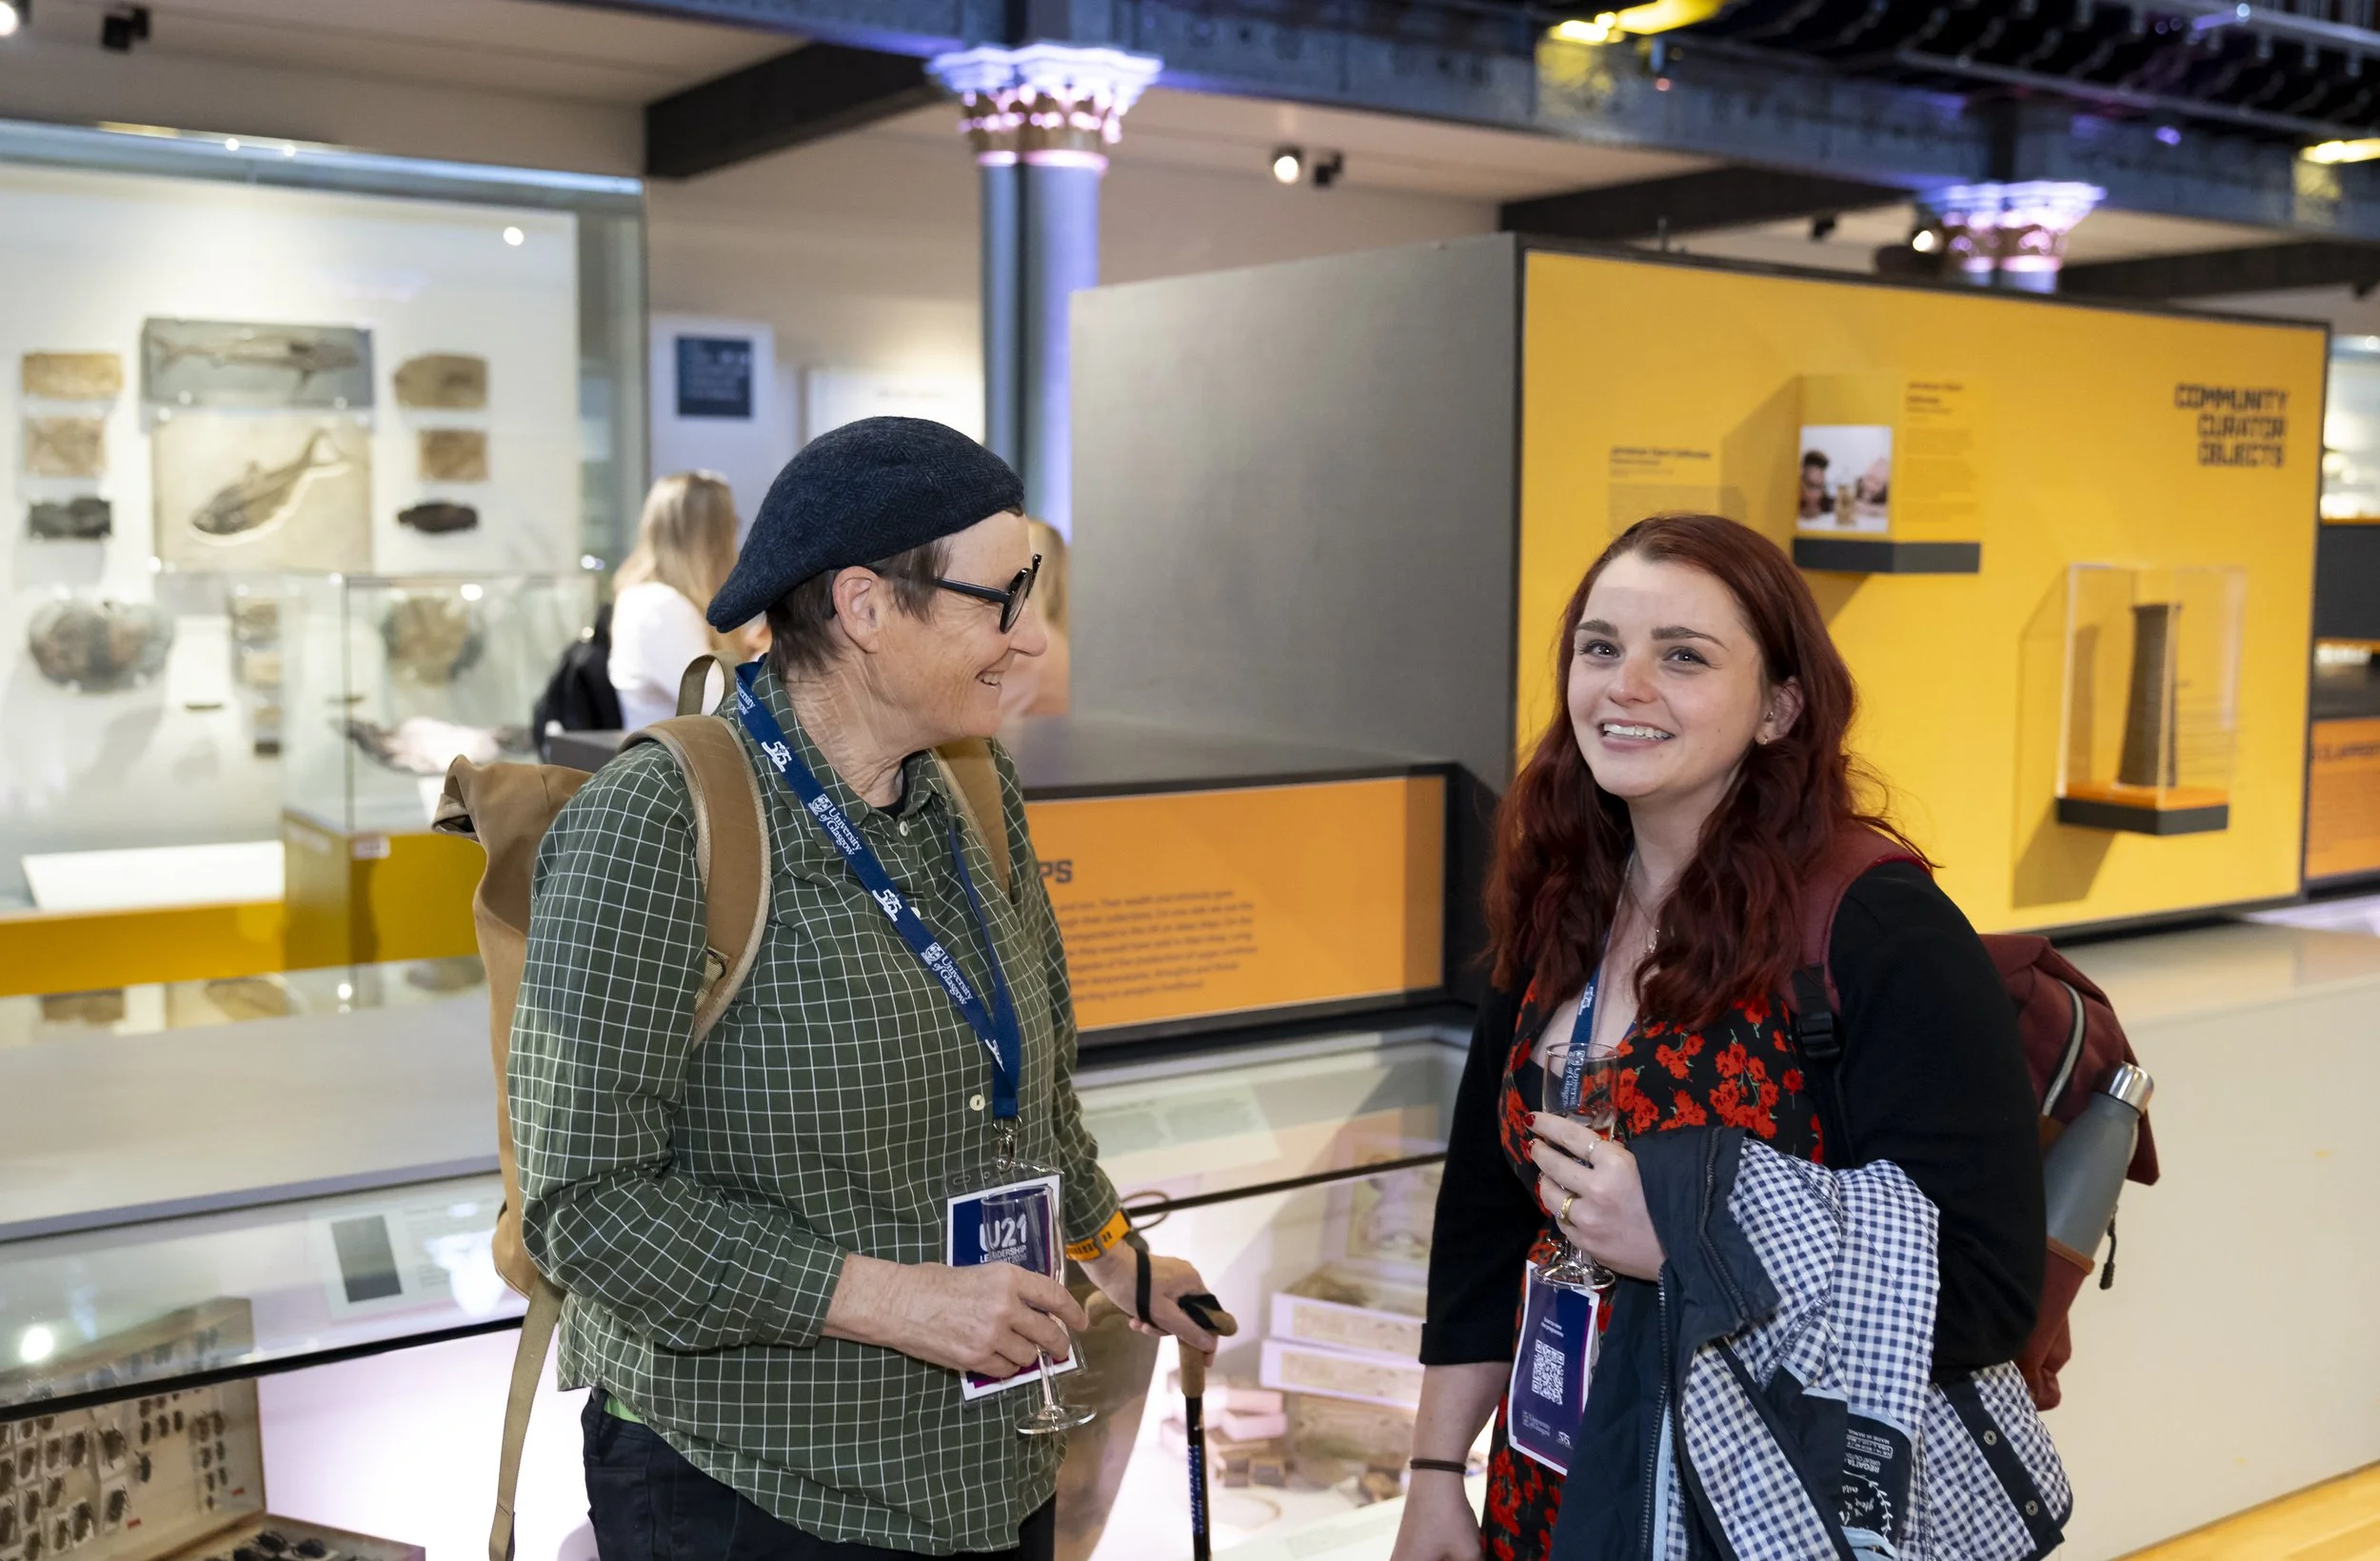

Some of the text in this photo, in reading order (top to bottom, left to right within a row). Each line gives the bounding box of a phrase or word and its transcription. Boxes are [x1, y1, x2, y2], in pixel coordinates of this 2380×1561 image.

[2174, 383, 2289, 411] COMMUNITY
[2197, 413, 2286, 439] CURATOR
[2197, 441, 2284, 468] OBJECTS
[819, 814, 855, 856] of Glasgow
[828, 806, 863, 851] University
[933, 963, 967, 1005] of Glasgow
[941, 955, 974, 1000] University
[979, 1213, 1027, 1252] U21
